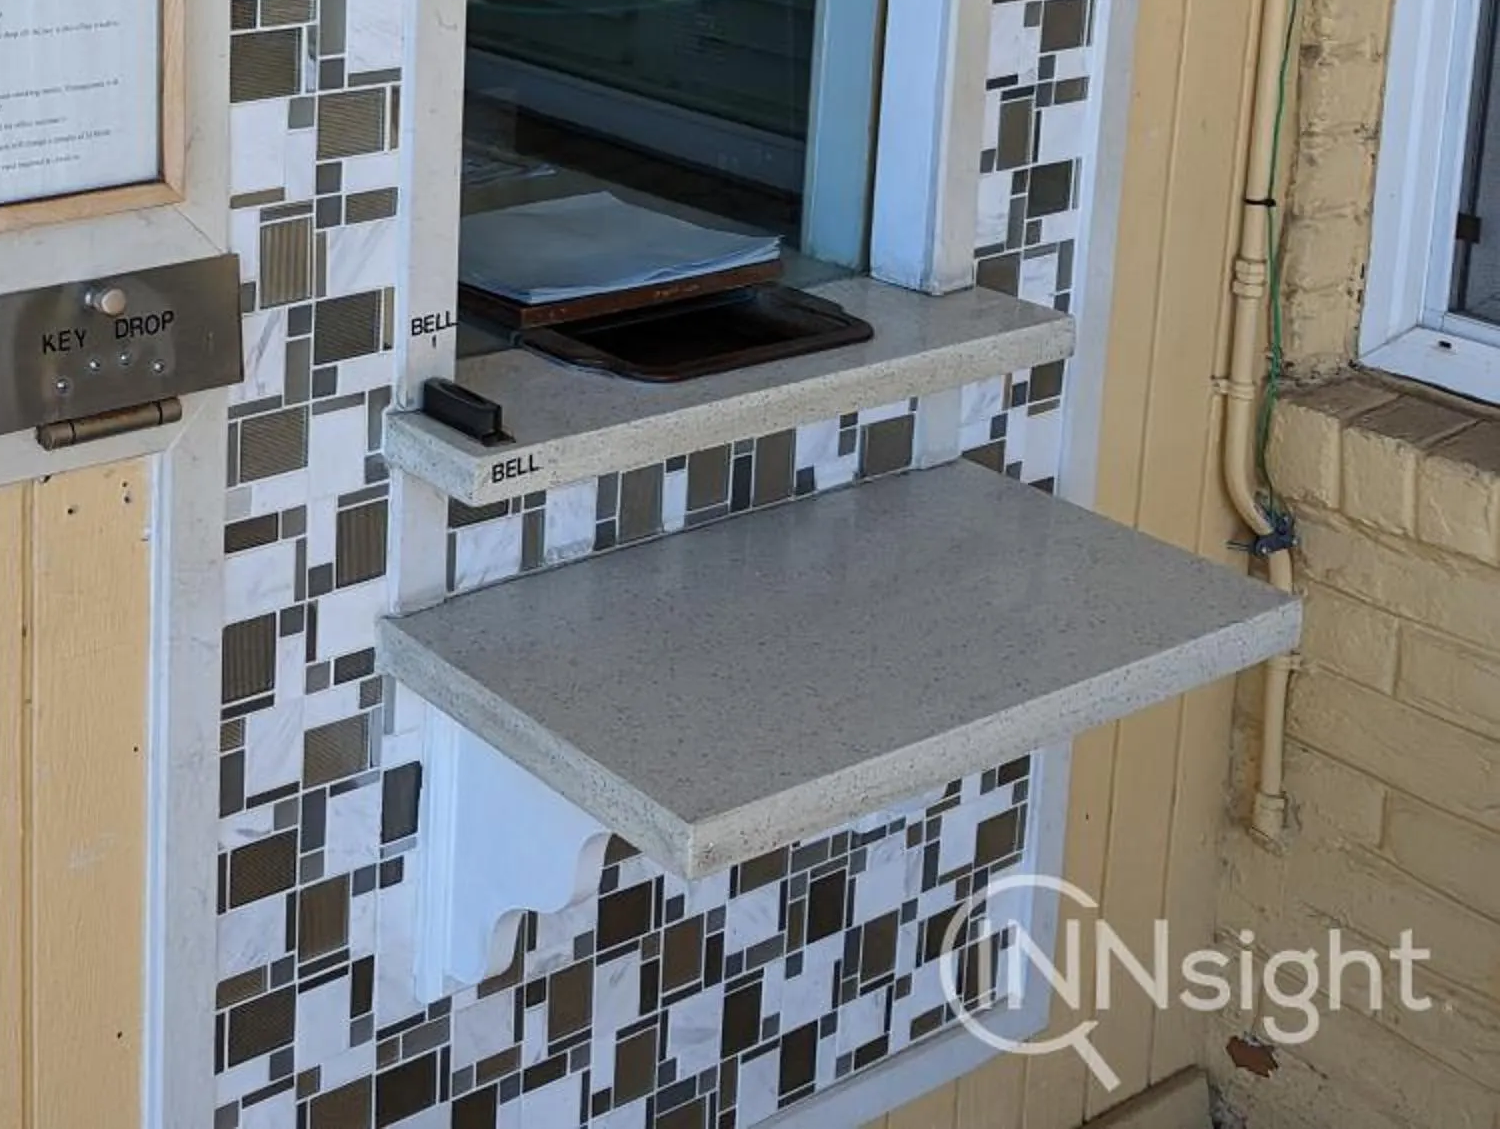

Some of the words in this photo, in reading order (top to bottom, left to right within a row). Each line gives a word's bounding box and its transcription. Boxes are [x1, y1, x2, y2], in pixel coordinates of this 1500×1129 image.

[42, 329, 87, 354] KEY
[115, 310, 175, 339] DROP
[411, 311, 459, 336] BELL
[492, 454, 541, 483] BELL
